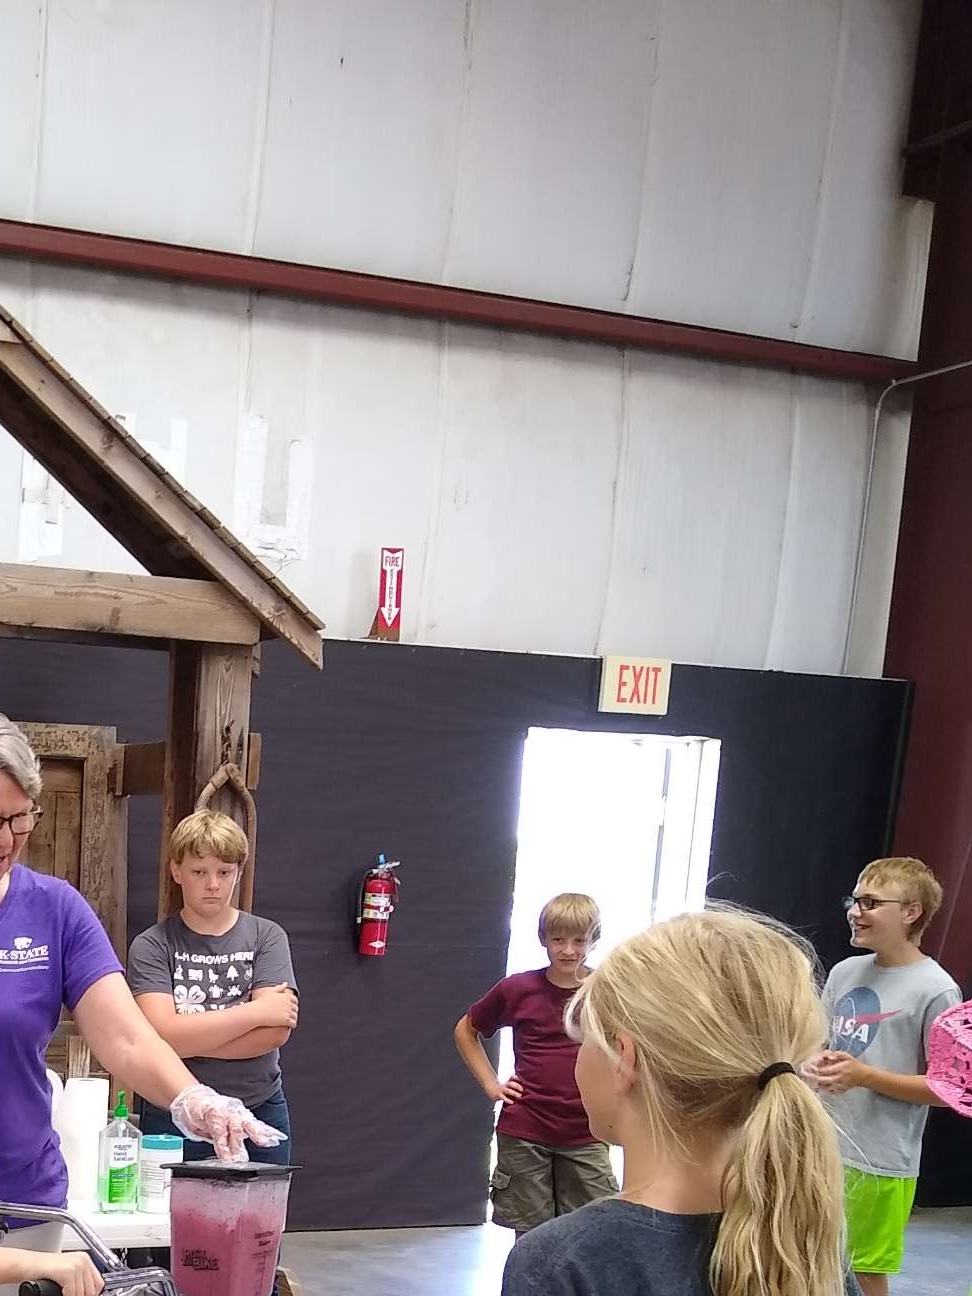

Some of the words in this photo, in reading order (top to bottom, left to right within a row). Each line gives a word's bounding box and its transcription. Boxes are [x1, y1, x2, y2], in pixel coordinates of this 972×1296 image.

[384, 555, 401, 567] FIRE
[616, 664, 662, 705] EXIT
[190, 953, 229, 965] GROWS
